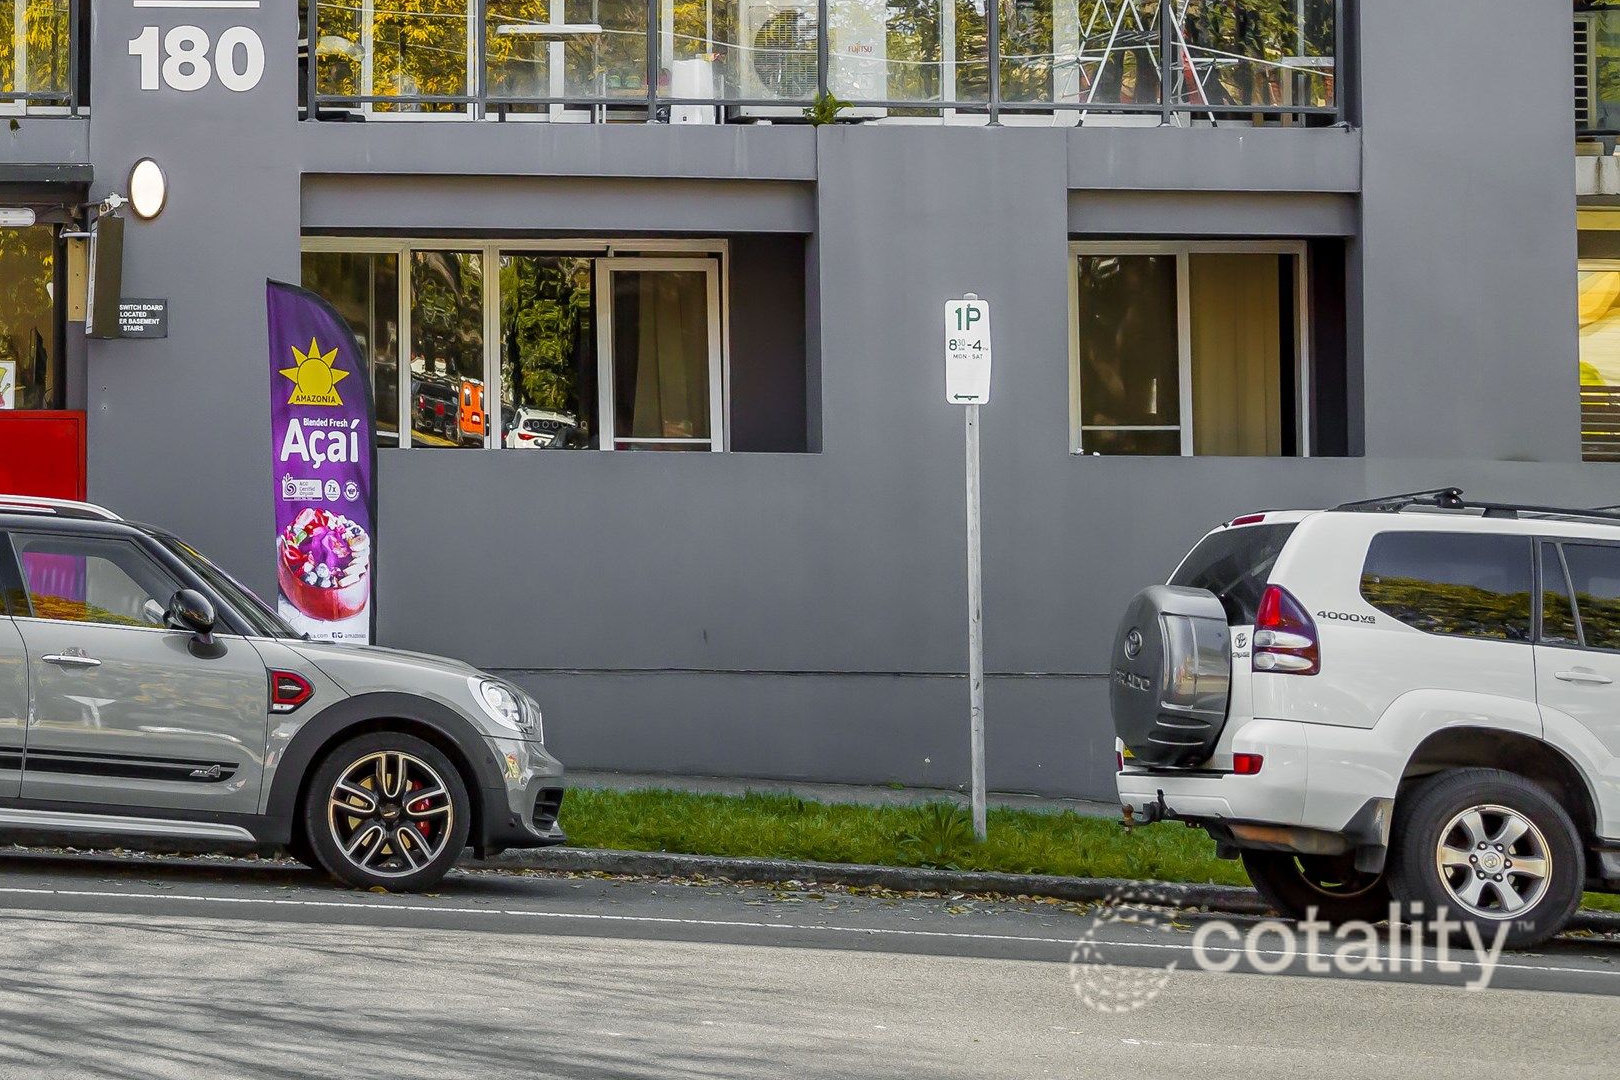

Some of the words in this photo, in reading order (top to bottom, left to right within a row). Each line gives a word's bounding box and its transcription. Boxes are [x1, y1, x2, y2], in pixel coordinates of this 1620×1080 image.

[128, 25, 265, 92] 180
[955, 307, 981, 331] 1P
[295, 394, 337, 403] AMAZONIA
[303, 417, 328, 427] Blended
[329, 418, 349, 428] Fresh
[280, 418, 361, 469] Açaí
